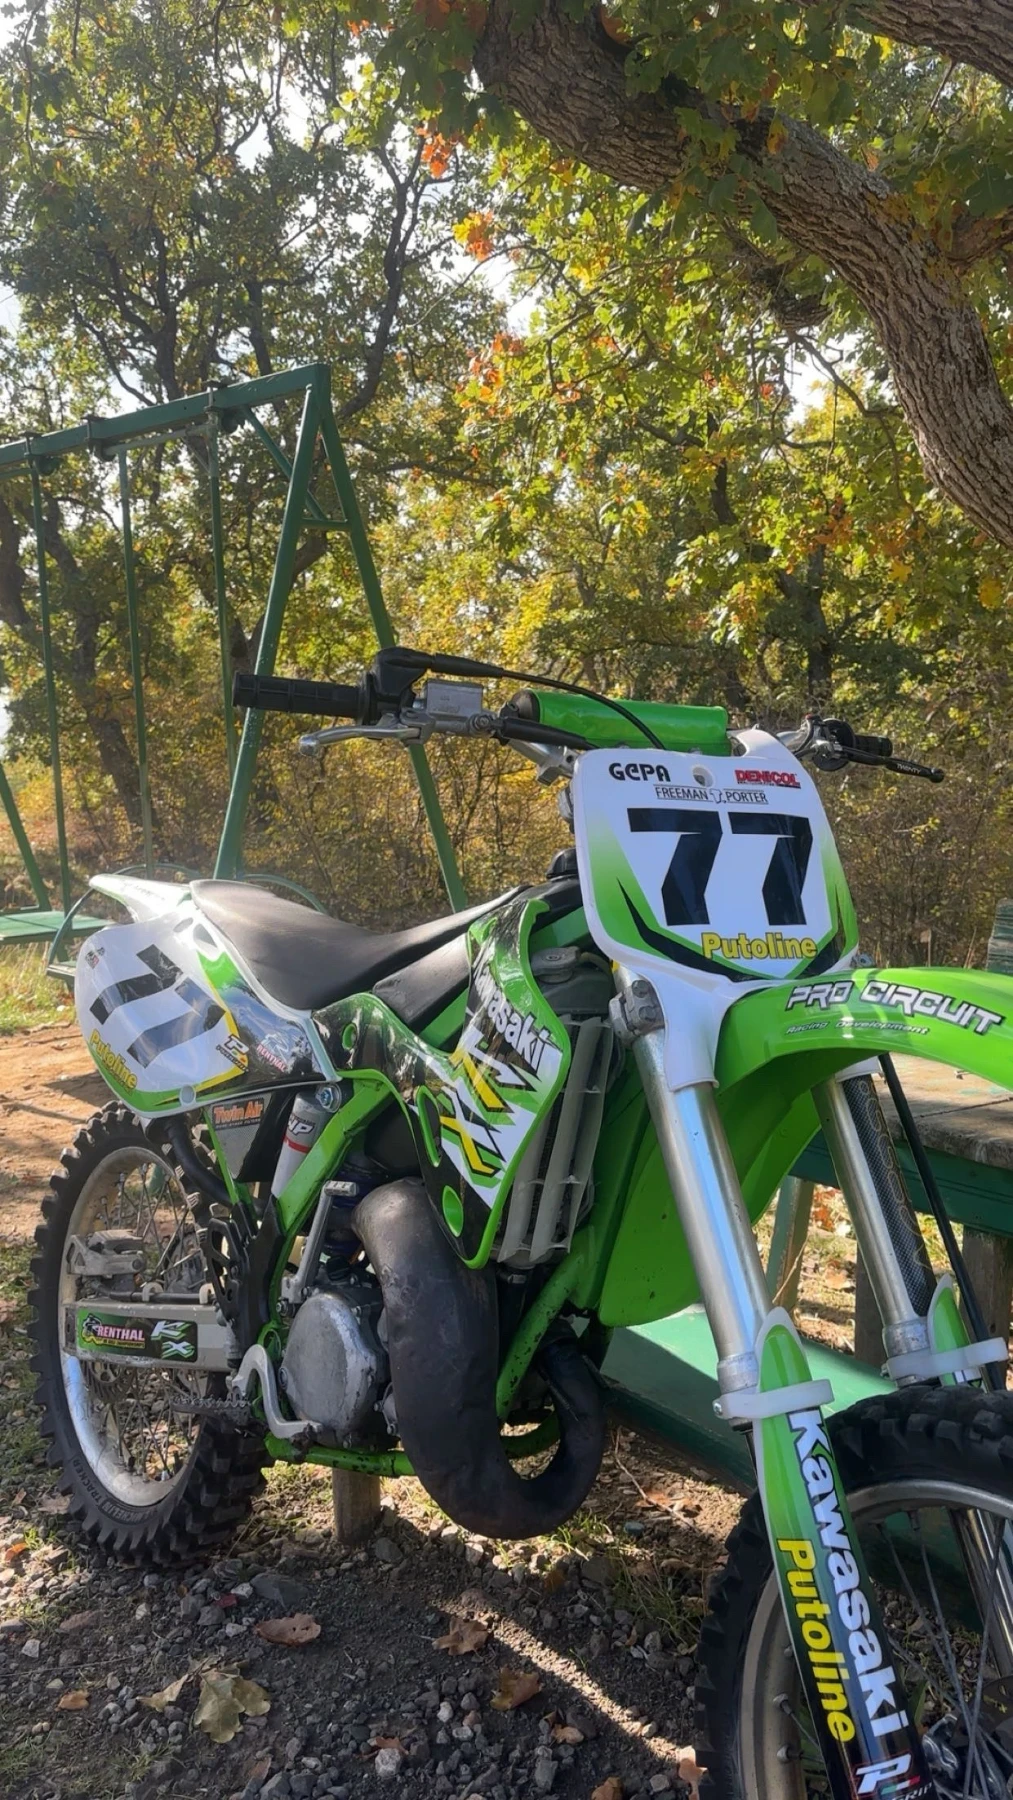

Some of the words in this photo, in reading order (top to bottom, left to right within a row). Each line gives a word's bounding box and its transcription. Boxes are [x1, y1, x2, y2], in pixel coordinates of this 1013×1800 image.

[734, 769, 801, 788] DENICOL
[896, 762, 921, 775] TWENTY
[656, 787, 709, 801] FREEMAN
[725, 790, 769, 804] PORTER
[627, 808, 813, 926] 77
[701, 932, 818, 960] Putoline
[785, 980, 855, 1012] PRO
[860, 980, 1006, 1036] CIRCUIT
[785, 1021, 829, 1035] Racing
[835, 1021, 930, 1035] Development
[90, 1027, 138, 1090] Putoline
[256, 1043, 289, 1073] RENTHAL
[213, 1103, 244, 1124] Twin
[244, 1100, 264, 1118] Air
[97, 1324, 146, 1342] RENTHAL
[72, 1459, 102, 1504] TRACKER
[787, 1407, 909, 1738] Kawasaki
[776, 1538, 856, 1743] Putoline
